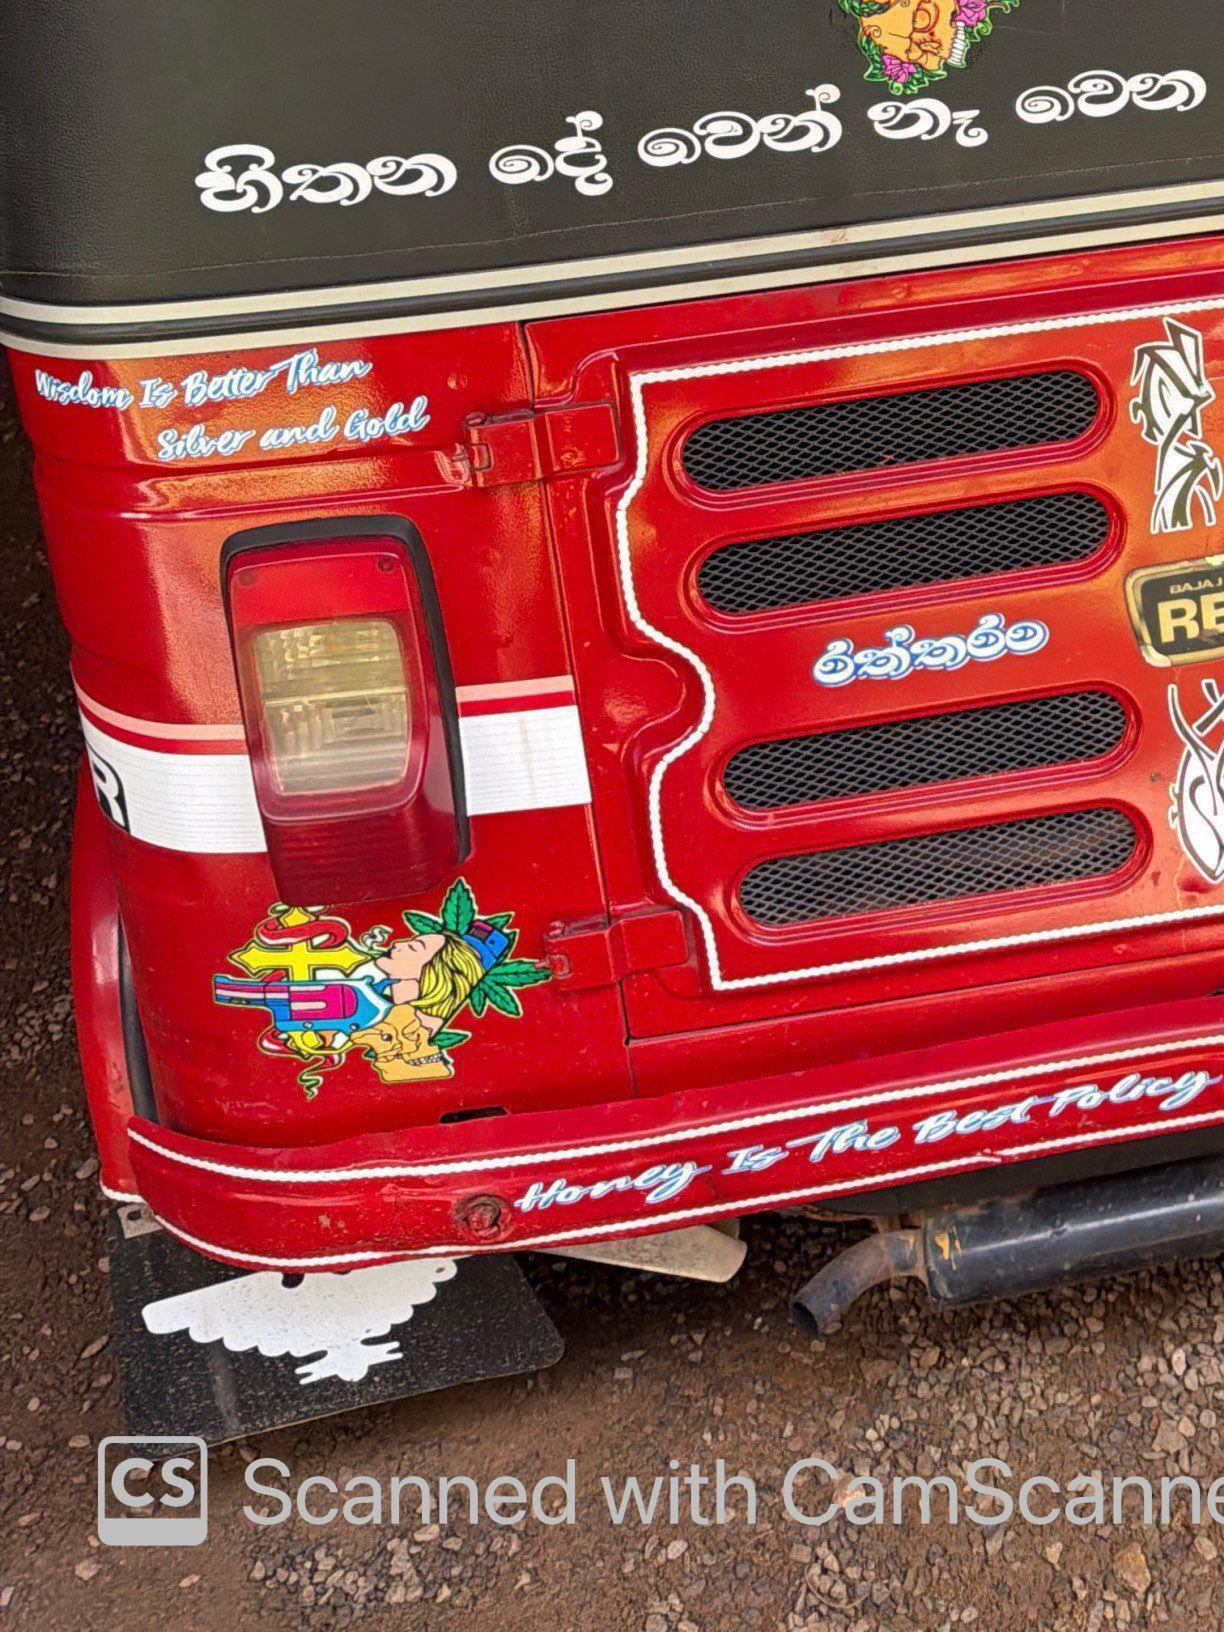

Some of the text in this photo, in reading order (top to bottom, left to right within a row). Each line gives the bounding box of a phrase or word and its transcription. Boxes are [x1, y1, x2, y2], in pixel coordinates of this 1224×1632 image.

[194, 142, 458, 214] හිතන
[488, 109, 615, 198] දේ
[34, 347, 373, 410] Wisdom Is Better Than
[157, 395, 431, 462] Silver and Gold
[1169, 577, 1223, 595] BAJAJ
[513, 1068, 1222, 1213] Honey Is The Best Policy
